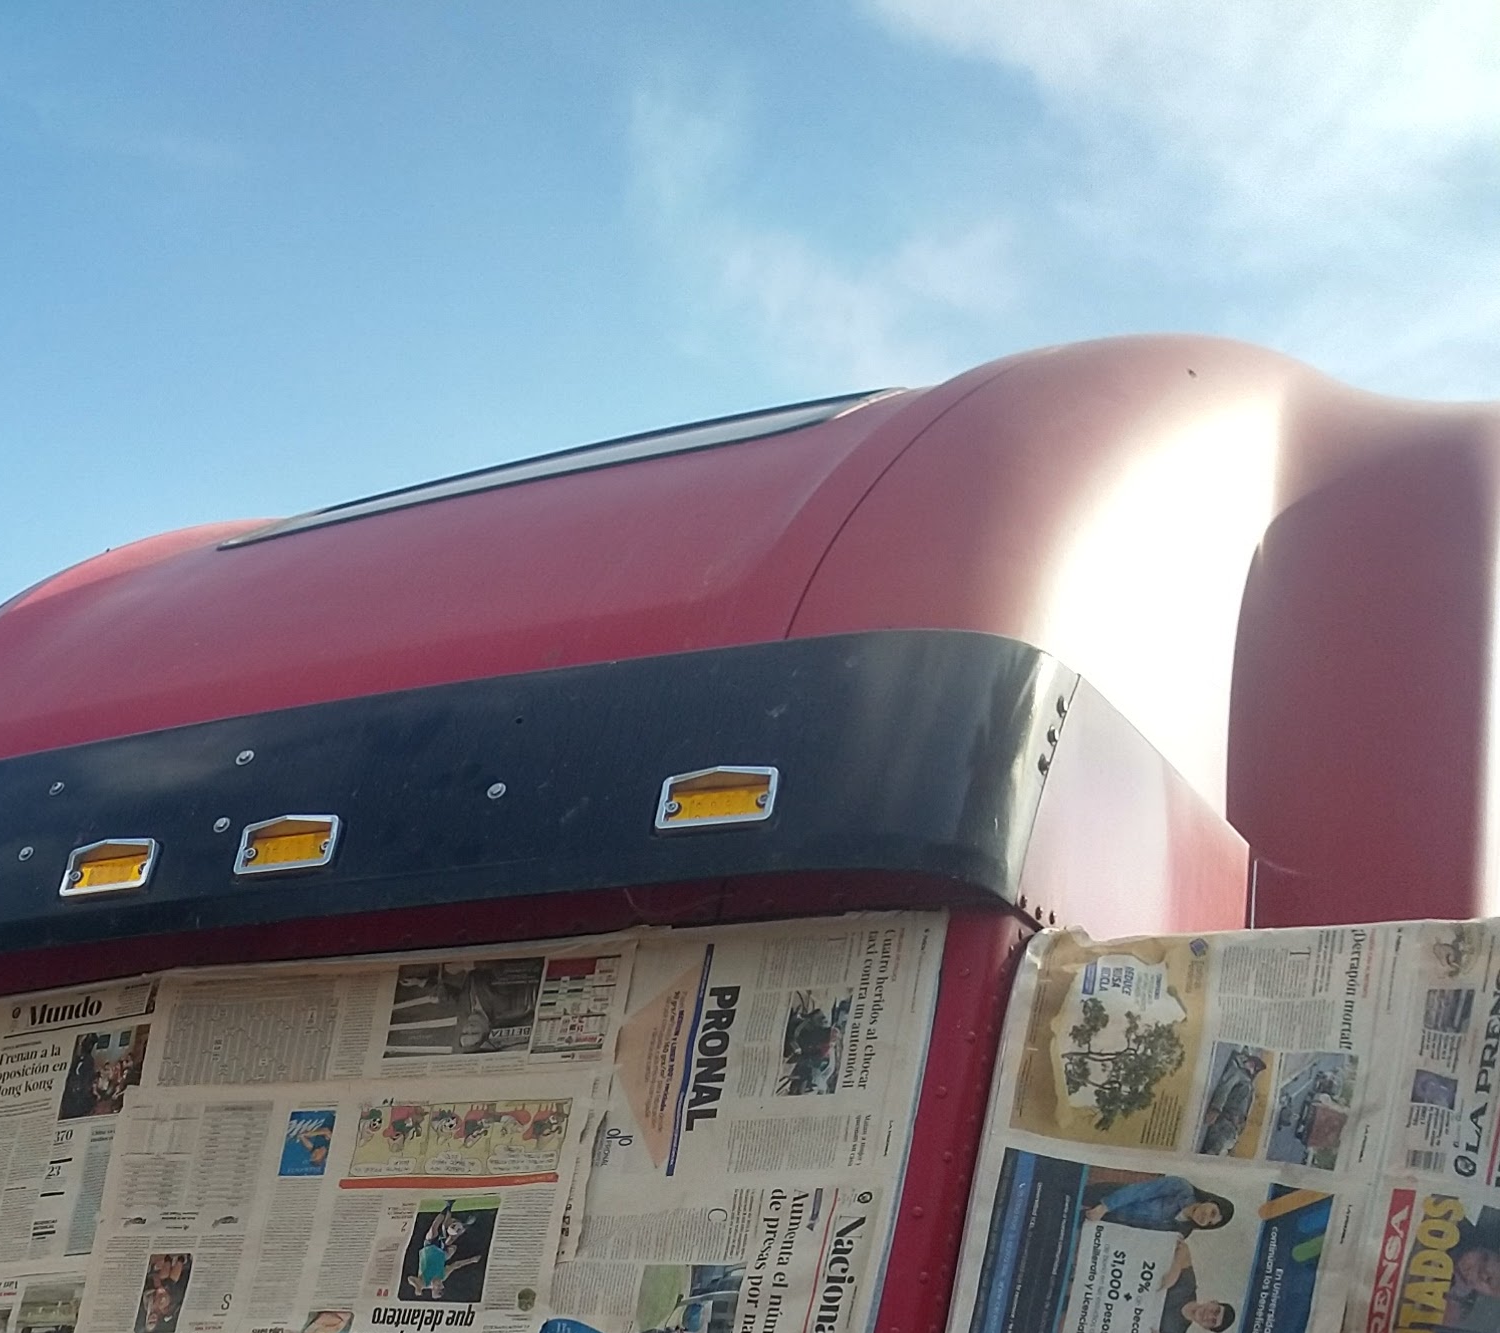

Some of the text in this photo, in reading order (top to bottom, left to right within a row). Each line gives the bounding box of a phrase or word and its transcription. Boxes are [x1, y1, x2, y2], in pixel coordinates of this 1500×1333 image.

[1339, 929, 1367, 1050] ¡Derrapón mortal!
[30, 996, 102, 1026] Mundo
[842, 930, 880, 1088] taxi contra un automóvil
[858, 929, 896, 1090] Cuatro heridos al chocar
[40, 1049, 48, 1057] a
[50, 1044, 61, 1057] la
[685, 986, 740, 1131] PRONAL
[53, 1062, 68, 1072] en
[24, 1077, 54, 1093] Kong
[54, 1129, 74, 1143] 370
[1466, 1102, 1488, 1154] LA
[45, 1166, 61, 1178] 23
[768, 1188, 787, 1210] de
[776, 1189, 810, 1266] Aumenta
[754, 1217, 780, 1270] presas
[1090, 1225, 1104, 1280] Bachillerato
[772, 1272, 789, 1288] el
[1086, 1282, 1094, 1291] y
[1108, 1250, 1126, 1301] $1,000
[1138, 1260, 1156, 1294] 20%
[1260, 1276, 1269, 1290] los
[1276, 1268, 1284, 1278] En
[748, 1275, 764, 1308] por
[372, 1304, 476, 1332] que delantero
